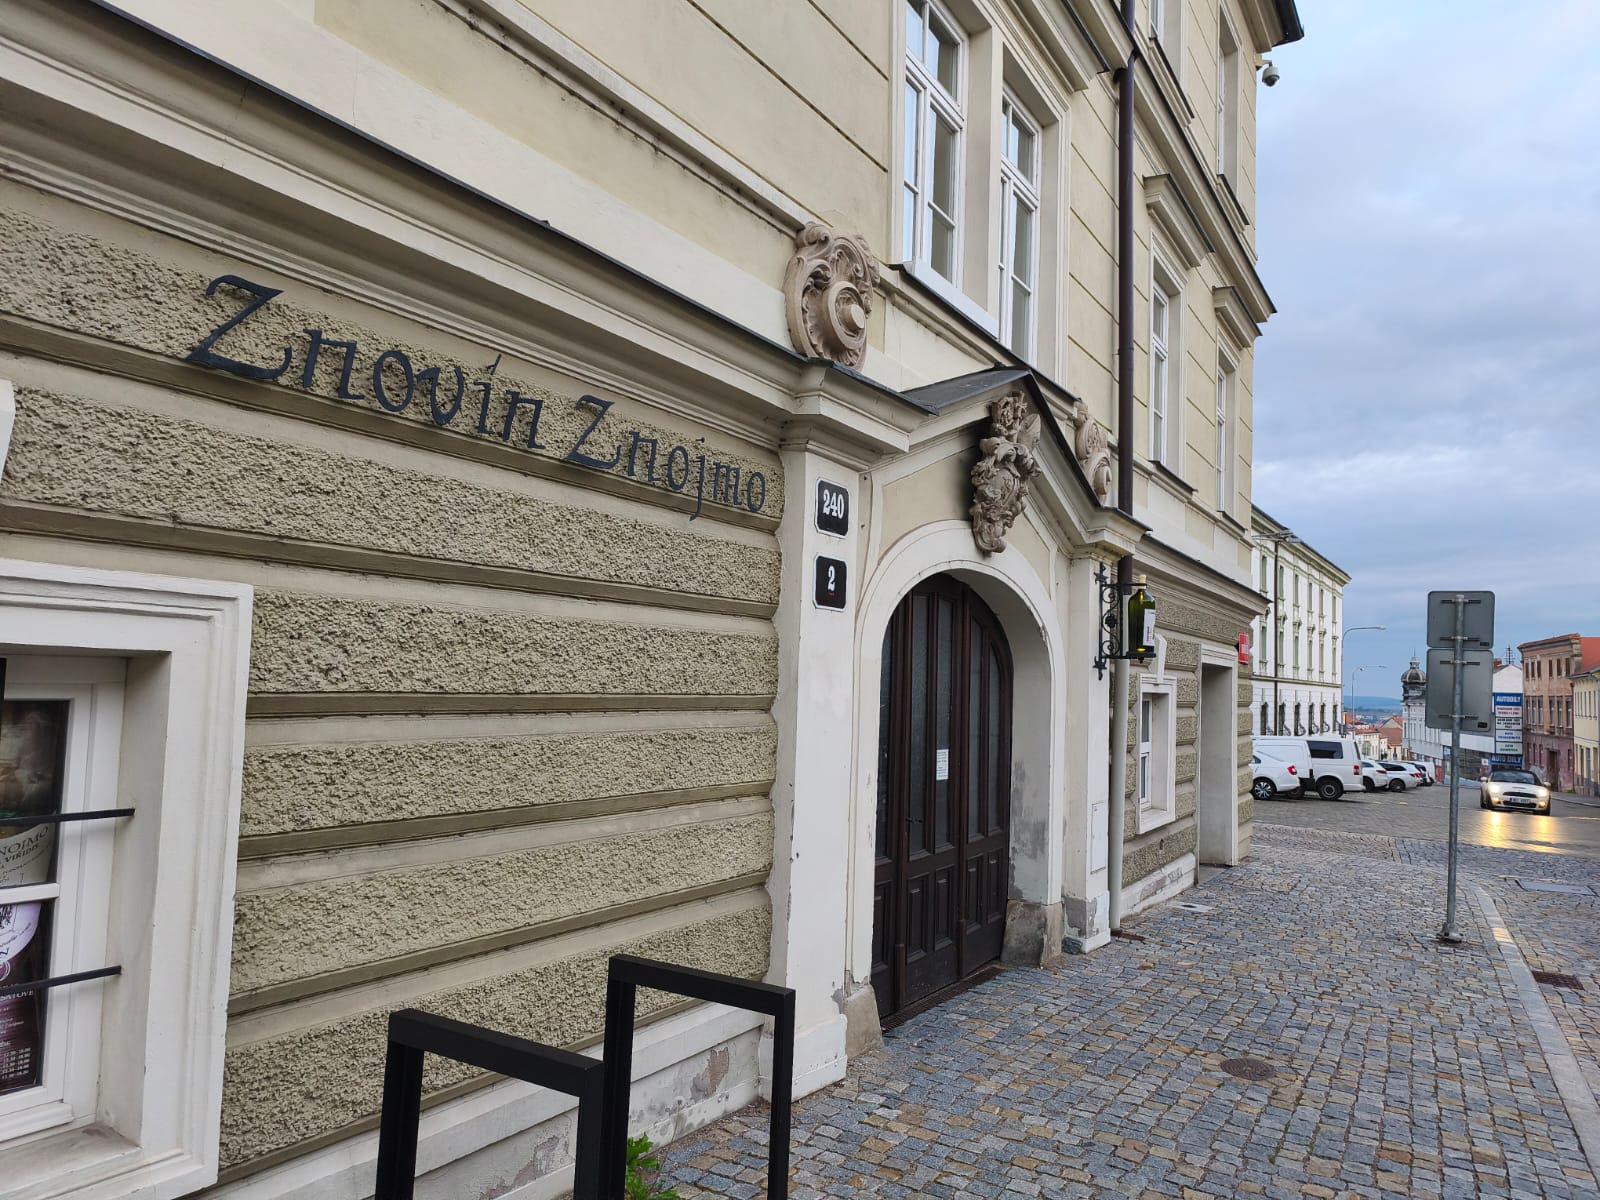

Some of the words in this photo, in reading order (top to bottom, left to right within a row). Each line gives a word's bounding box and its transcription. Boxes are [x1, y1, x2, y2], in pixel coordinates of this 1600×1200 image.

[185, 274, 546, 449] Znovín
[565, 394, 766, 521] Znojmo
[823, 489, 844, 519] 240
[828, 565, 836, 592] 2
